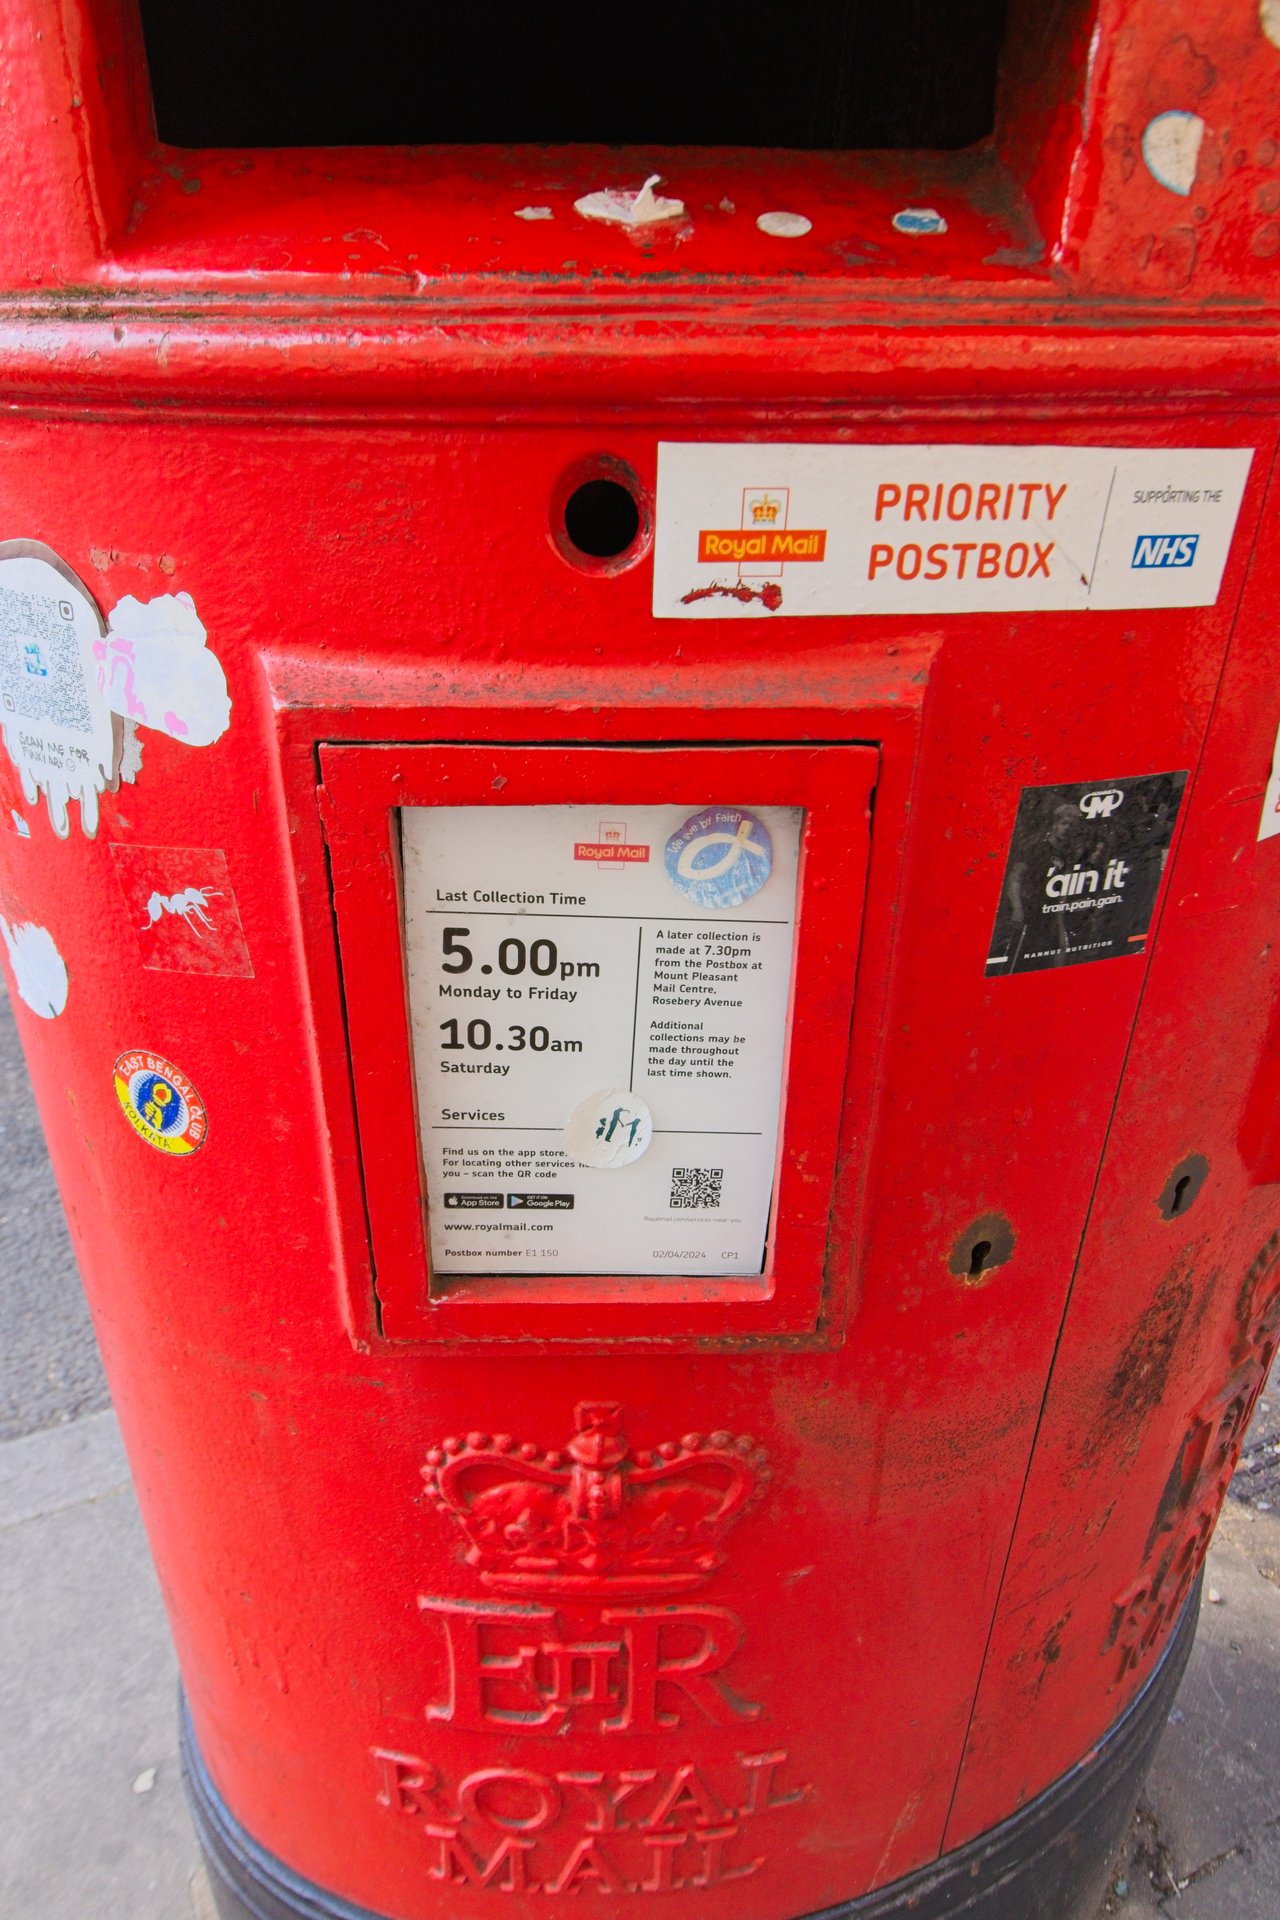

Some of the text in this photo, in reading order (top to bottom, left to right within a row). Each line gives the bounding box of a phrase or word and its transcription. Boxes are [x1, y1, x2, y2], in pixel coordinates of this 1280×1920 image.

[1132, 488, 1224, 503] SUPPORTING THE
[874, 483, 1067, 522] PRIORITY
[705, 534, 819, 559] Royal Mail
[1133, 536, 1198, 566] NHS
[868, 543, 1056, 581] POSTBOX
[47, 742, 64, 756] ME
[69, 746, 90, 763] FOR
[667, 838, 684, 854] We
[683, 824, 698, 840] live
[699, 816, 712, 830] by
[577, 845, 646, 859] Royal Mail
[1103, 859, 1129, 890] it
[436, 889, 587, 906] Last Collection Time
[656, 930, 761, 942] A later collection is
[655, 945, 751, 958] made at 7.30pm
[1065, 940, 1113, 953] NUTRITION
[441, 927, 600, 981] 5.00pm
[654, 958, 763, 970] from the Postbox at
[654, 971, 738, 982] Mount Pleasant
[439, 984, 578, 1003] Monday to Friday
[653, 983, 717, 995] Mail Centre,
[652, 996, 743, 1008] Rosebery Avenue
[650, 1020, 704, 1031] Additional
[440, 1018, 583, 1053] 10.30am
[649, 1033, 746, 1045] collections may be
[649, 1045, 740, 1056] made throughout
[440, 1061, 511, 1076] Saturday
[648, 1057, 734, 1067] the day until the
[647, 1069, 732, 1079] last time shown.
[119, 1055, 204, 1140] EAST BENGAL CLUB
[441, 1108, 506, 1121] Services
[123, 1100, 171, 1150] KOLKATA
[442, 1148, 464, 1156] Find
[498, 1148, 514, 1157] the
[517, 1150, 536, 1158] app
[539, 1149, 568, 1157] store.
[442, 1159, 459, 1167] For
[462, 1158, 502, 1168] locating
[505, 1159, 533, 1167] other
[535, 1160, 575, 1168] services
[498, 1170, 514, 1178] the
[517, 1170, 531, 1178] QR
[535, 1170, 557, 1178] code
[460, 1199, 500, 1207] App Store
[527, 1199, 570, 1208] Google Play
[444, 1223, 554, 1232] www.royalmail.com
[444, 1249, 559, 1257] Postbox number E1 150
[652, 1250, 738, 1260] 02/04/2024 CP1
[370, 1744, 815, 1832] ROYAL
[424, 1823, 767, 1896] MAIL
